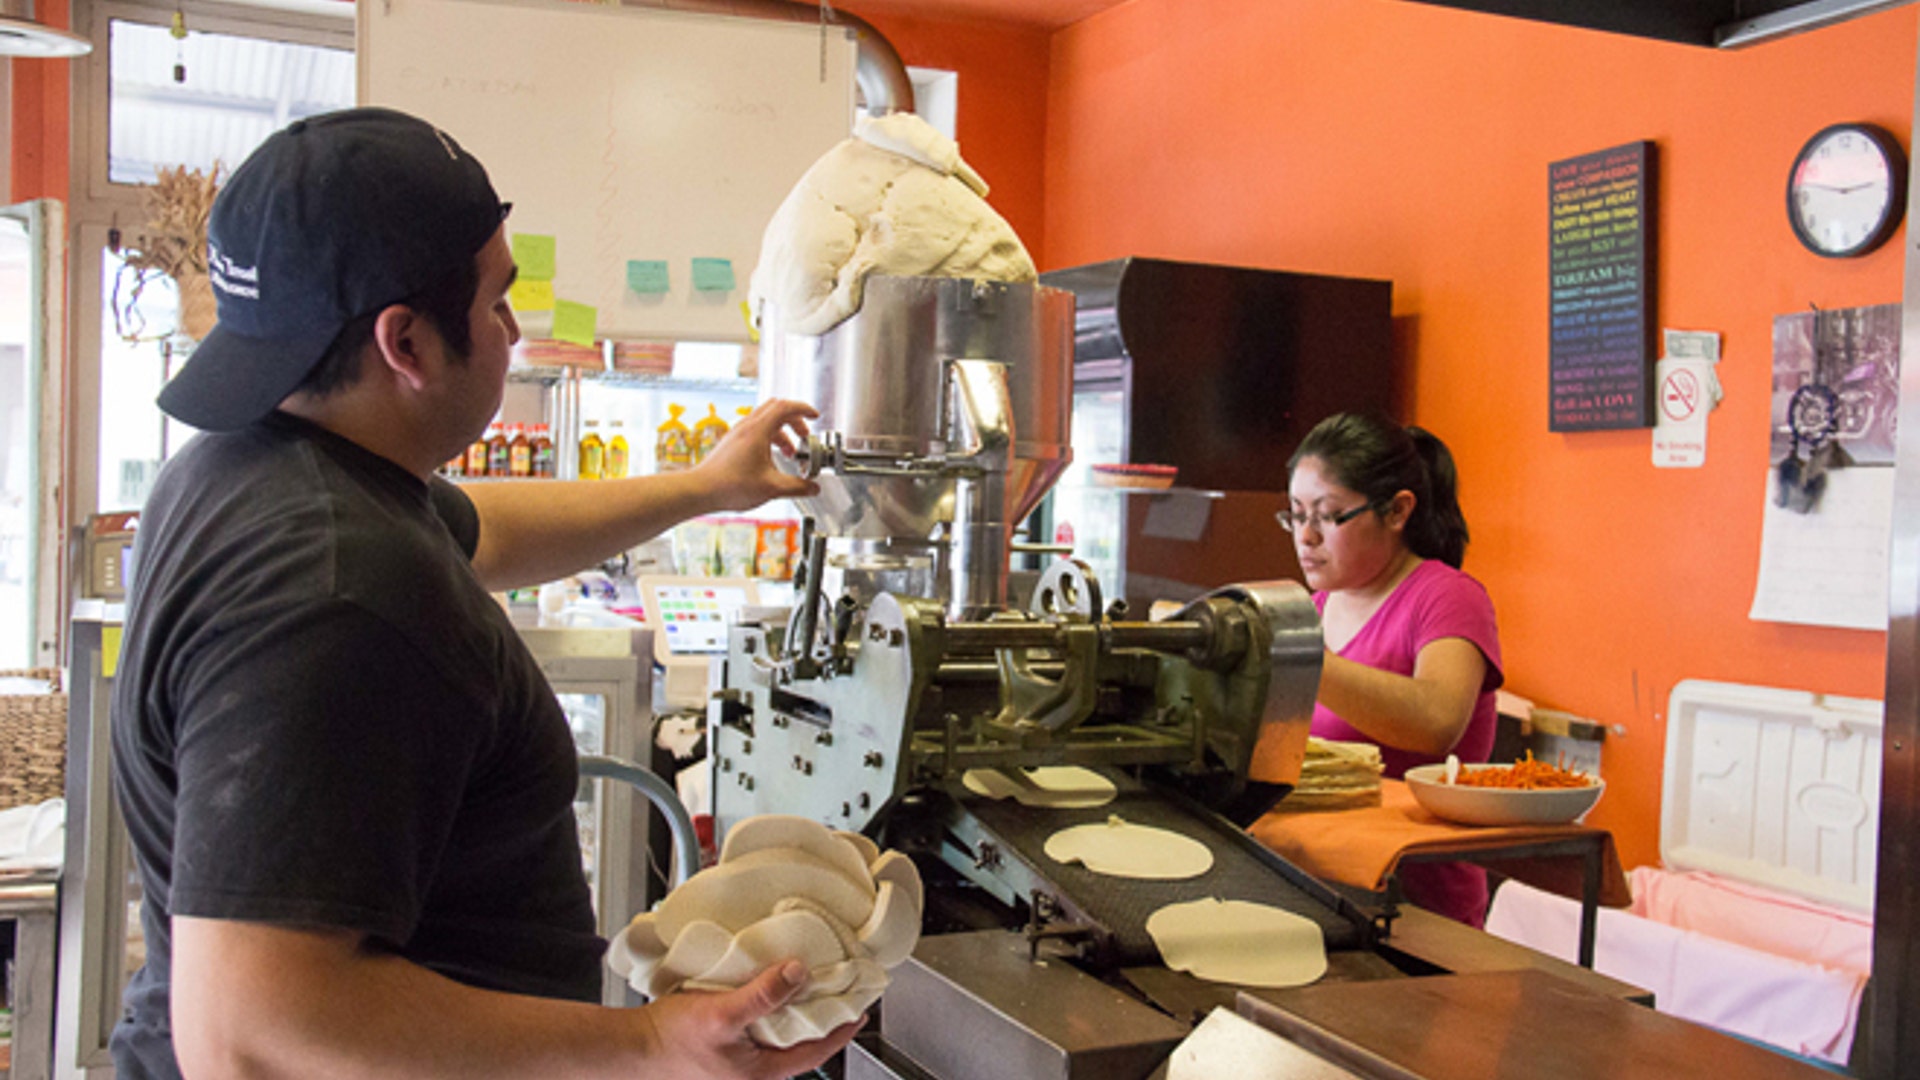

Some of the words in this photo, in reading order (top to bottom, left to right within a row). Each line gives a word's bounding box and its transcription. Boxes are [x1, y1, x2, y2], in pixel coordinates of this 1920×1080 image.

[1554, 266, 1613, 287] DREAM
[1616, 263, 1637, 279] big
[1669, 441, 1702, 452] Smoking
